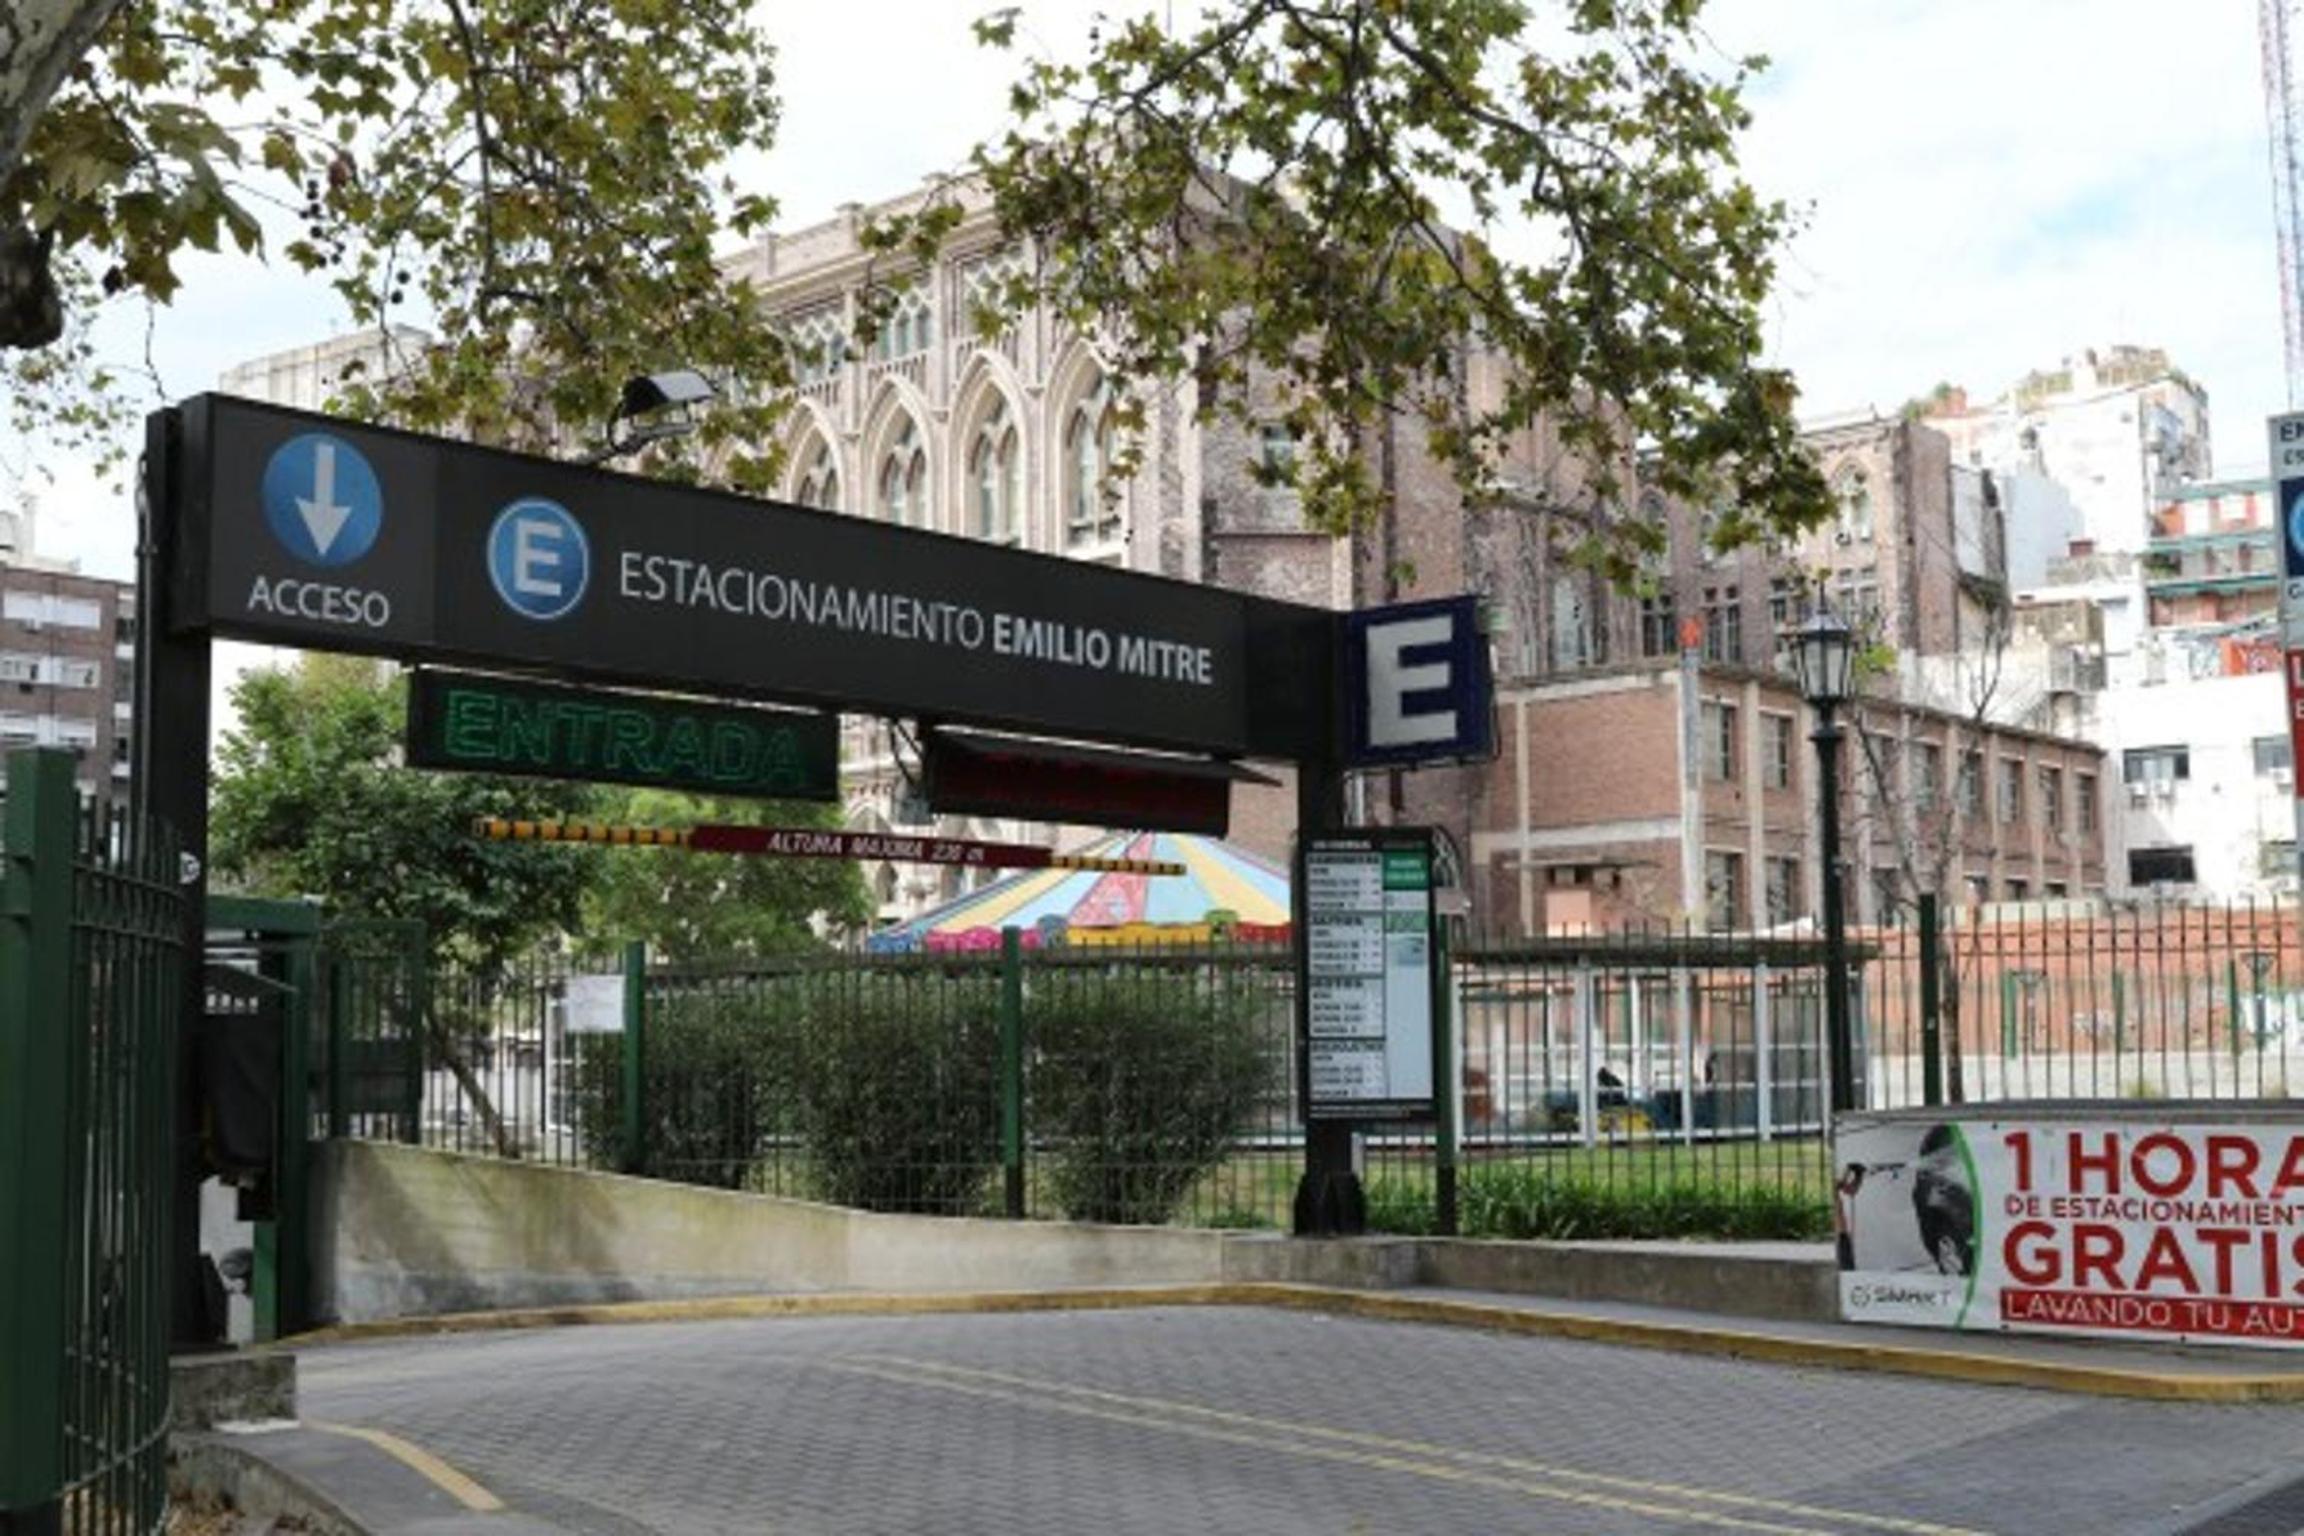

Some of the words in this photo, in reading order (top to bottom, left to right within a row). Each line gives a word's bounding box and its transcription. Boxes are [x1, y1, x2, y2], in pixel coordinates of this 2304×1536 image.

[514, 516, 563, 598] E
[248, 575, 390, 627] ACCESO
[620, 551, 986, 649] ESTACIONAMIENTO
[993, 613, 1112, 669] EMILIO
[1118, 633, 1214, 685] MITRE
[1366, 614, 1458, 747] E
[444, 689, 806, 789] ENTRADA
[2004, 1131, 2031, 1192] 1
[2005, 1195, 2041, 1218] DE
[2006, 1292, 2172, 1326] LAVANDO
[2184, 1302, 2230, 1331] TU
